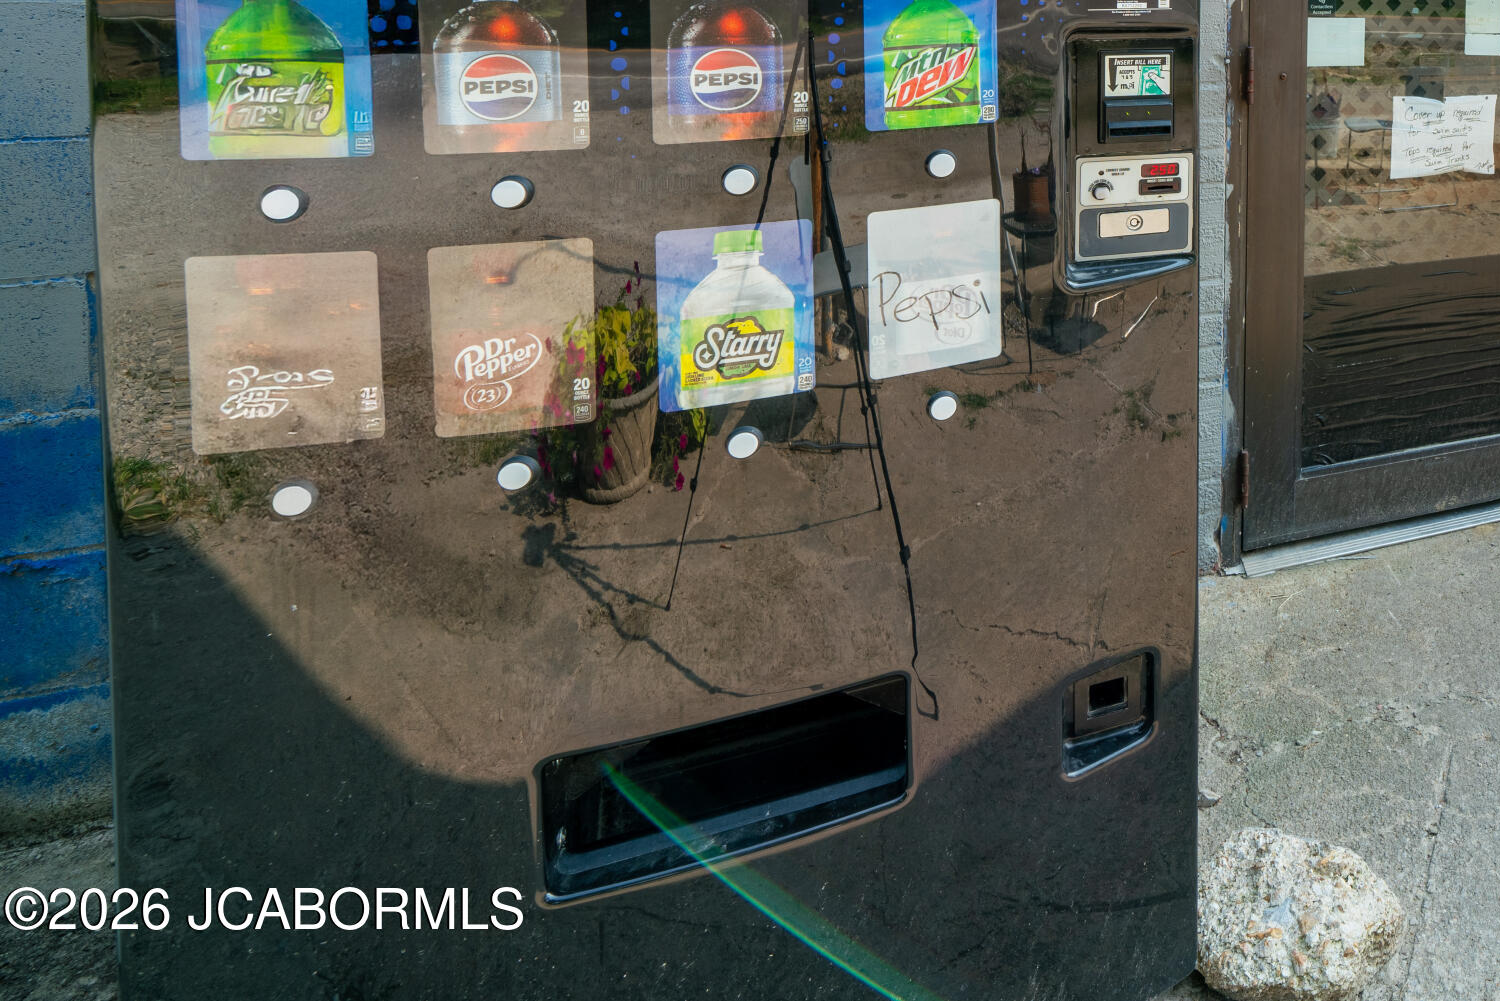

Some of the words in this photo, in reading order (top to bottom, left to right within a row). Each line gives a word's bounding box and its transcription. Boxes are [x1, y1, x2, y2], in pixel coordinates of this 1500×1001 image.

[694, 72, 758, 87] PEPSI
[464, 80, 533, 95] PEPSI
[983, 89, 995, 98] 20
[793, 91, 809, 104] 20
[573, 100, 590, 113] 20
[872, 271, 990, 331] Pepsi
[484, 338, 516, 360] Dr
[695, 327, 782, 369] Starry
[455, 343, 537, 382] Pepper
[799, 357, 812, 367] 20
[573, 378, 590, 391] 20
[477, 389, 496, 403] 23
